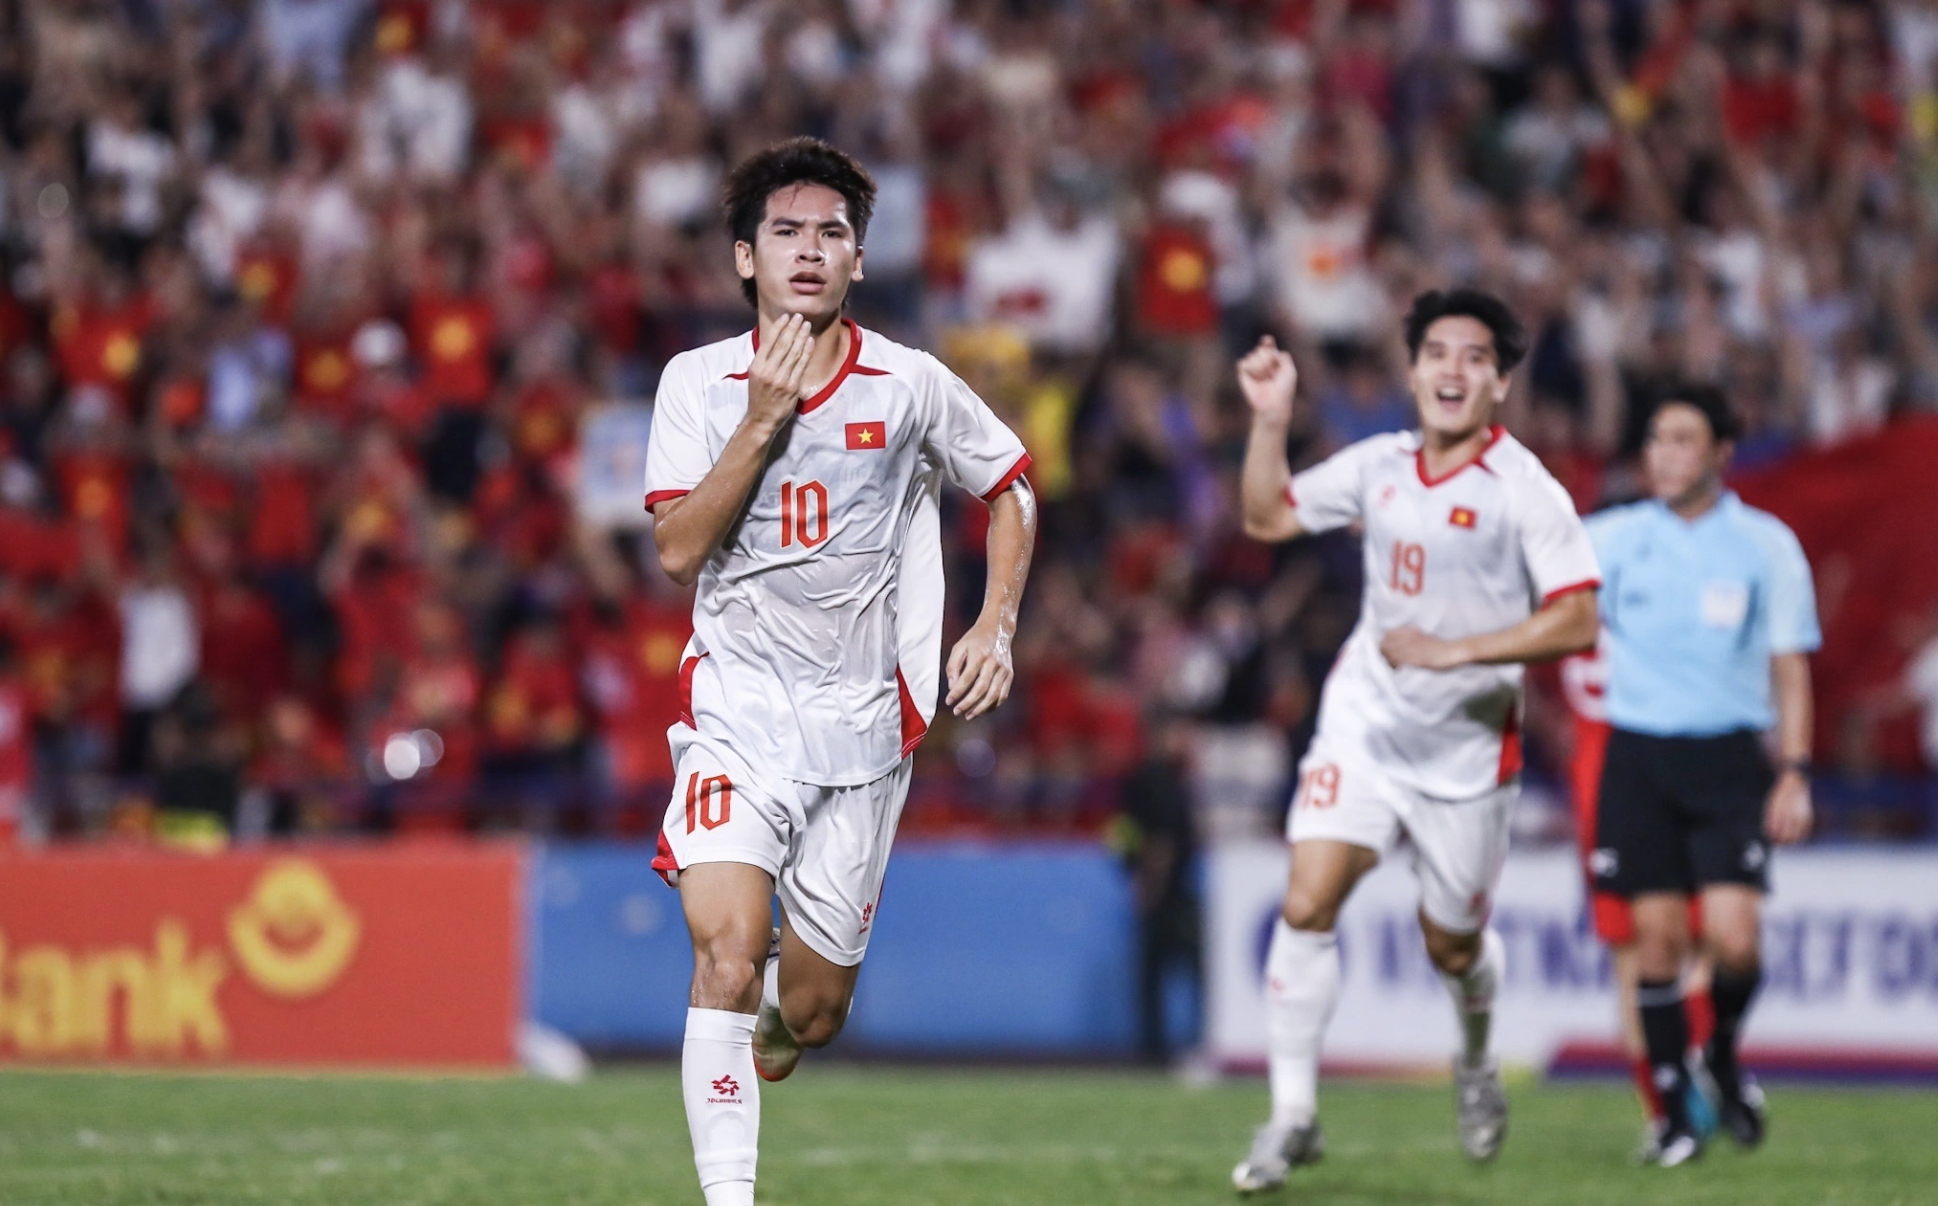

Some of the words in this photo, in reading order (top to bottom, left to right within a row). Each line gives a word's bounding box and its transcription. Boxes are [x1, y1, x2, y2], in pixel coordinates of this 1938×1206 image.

[780, 479, 829, 549] 10
[1391, 540, 1426, 596] 19
[686, 771, 732, 834] 10
[0, 918, 230, 1052] ank
